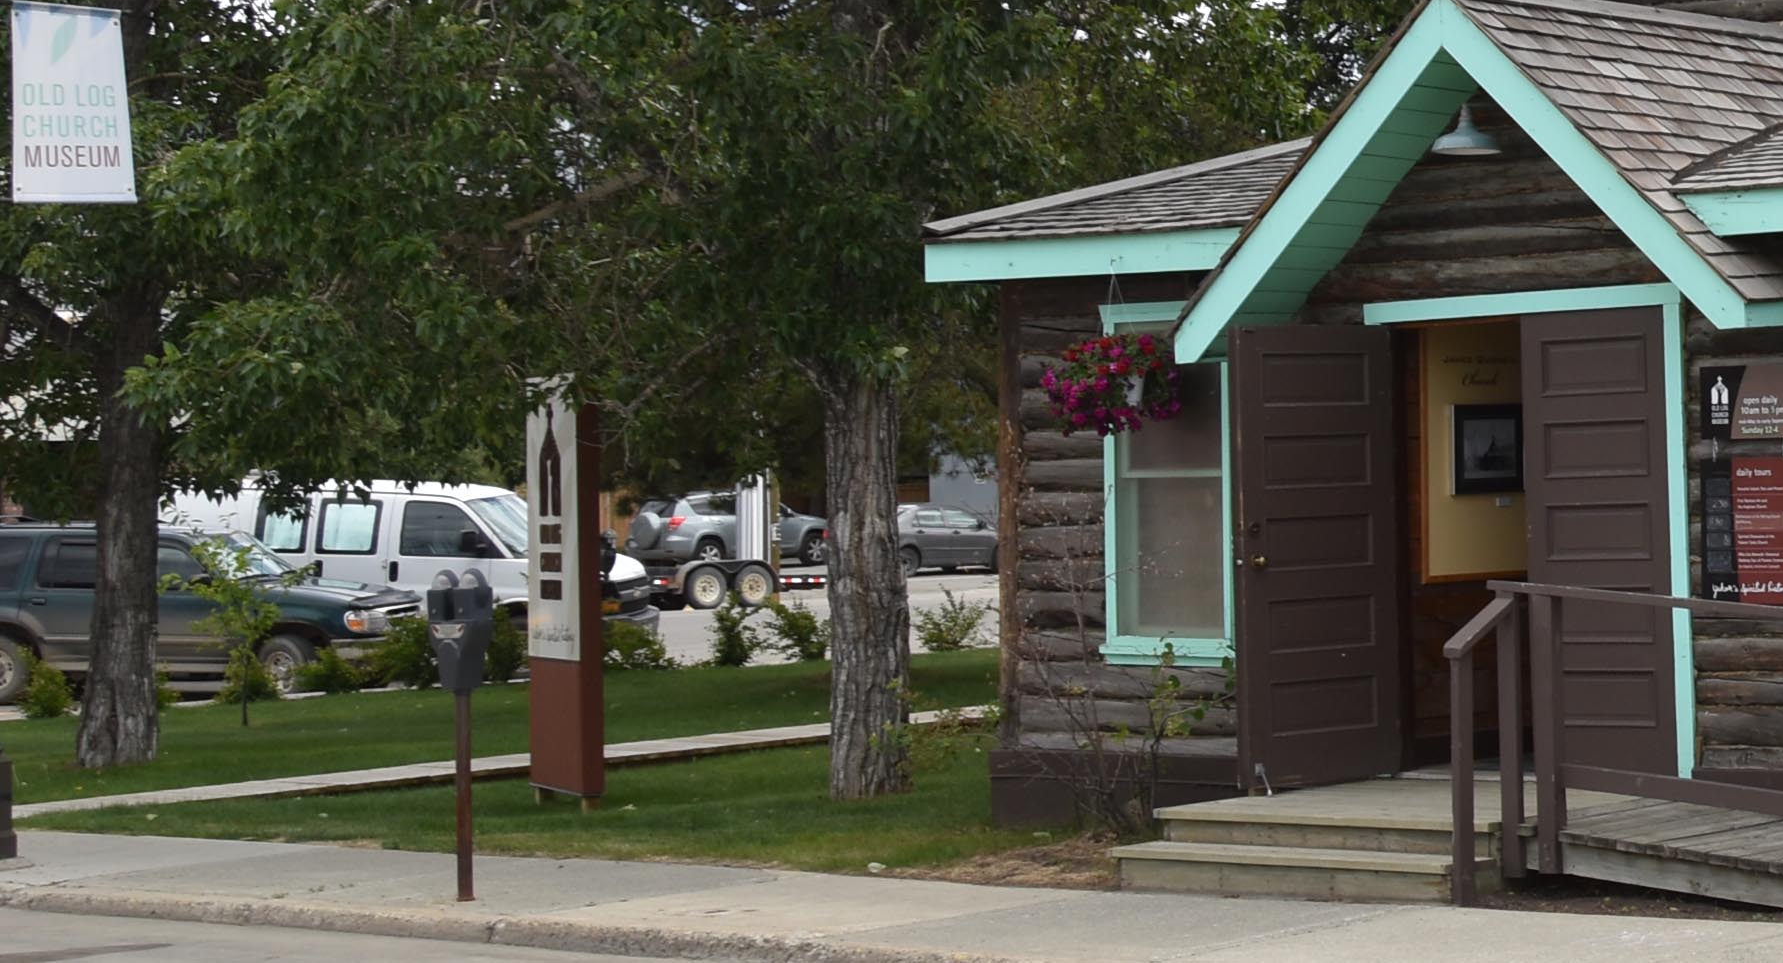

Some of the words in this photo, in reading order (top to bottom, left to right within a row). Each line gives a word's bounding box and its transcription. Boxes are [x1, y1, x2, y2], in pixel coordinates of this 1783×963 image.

[22, 83, 64, 106] OLD
[76, 84, 116, 107] LOG
[22, 114, 118, 138] CHURCH
[24, 145, 121, 168] MUSEUM
[1743, 397, 1760, 406] open
[1761, 395, 1778, 405] daily
[1736, 468, 1752, 478] daily
[1754, 468, 1772, 477] tours
